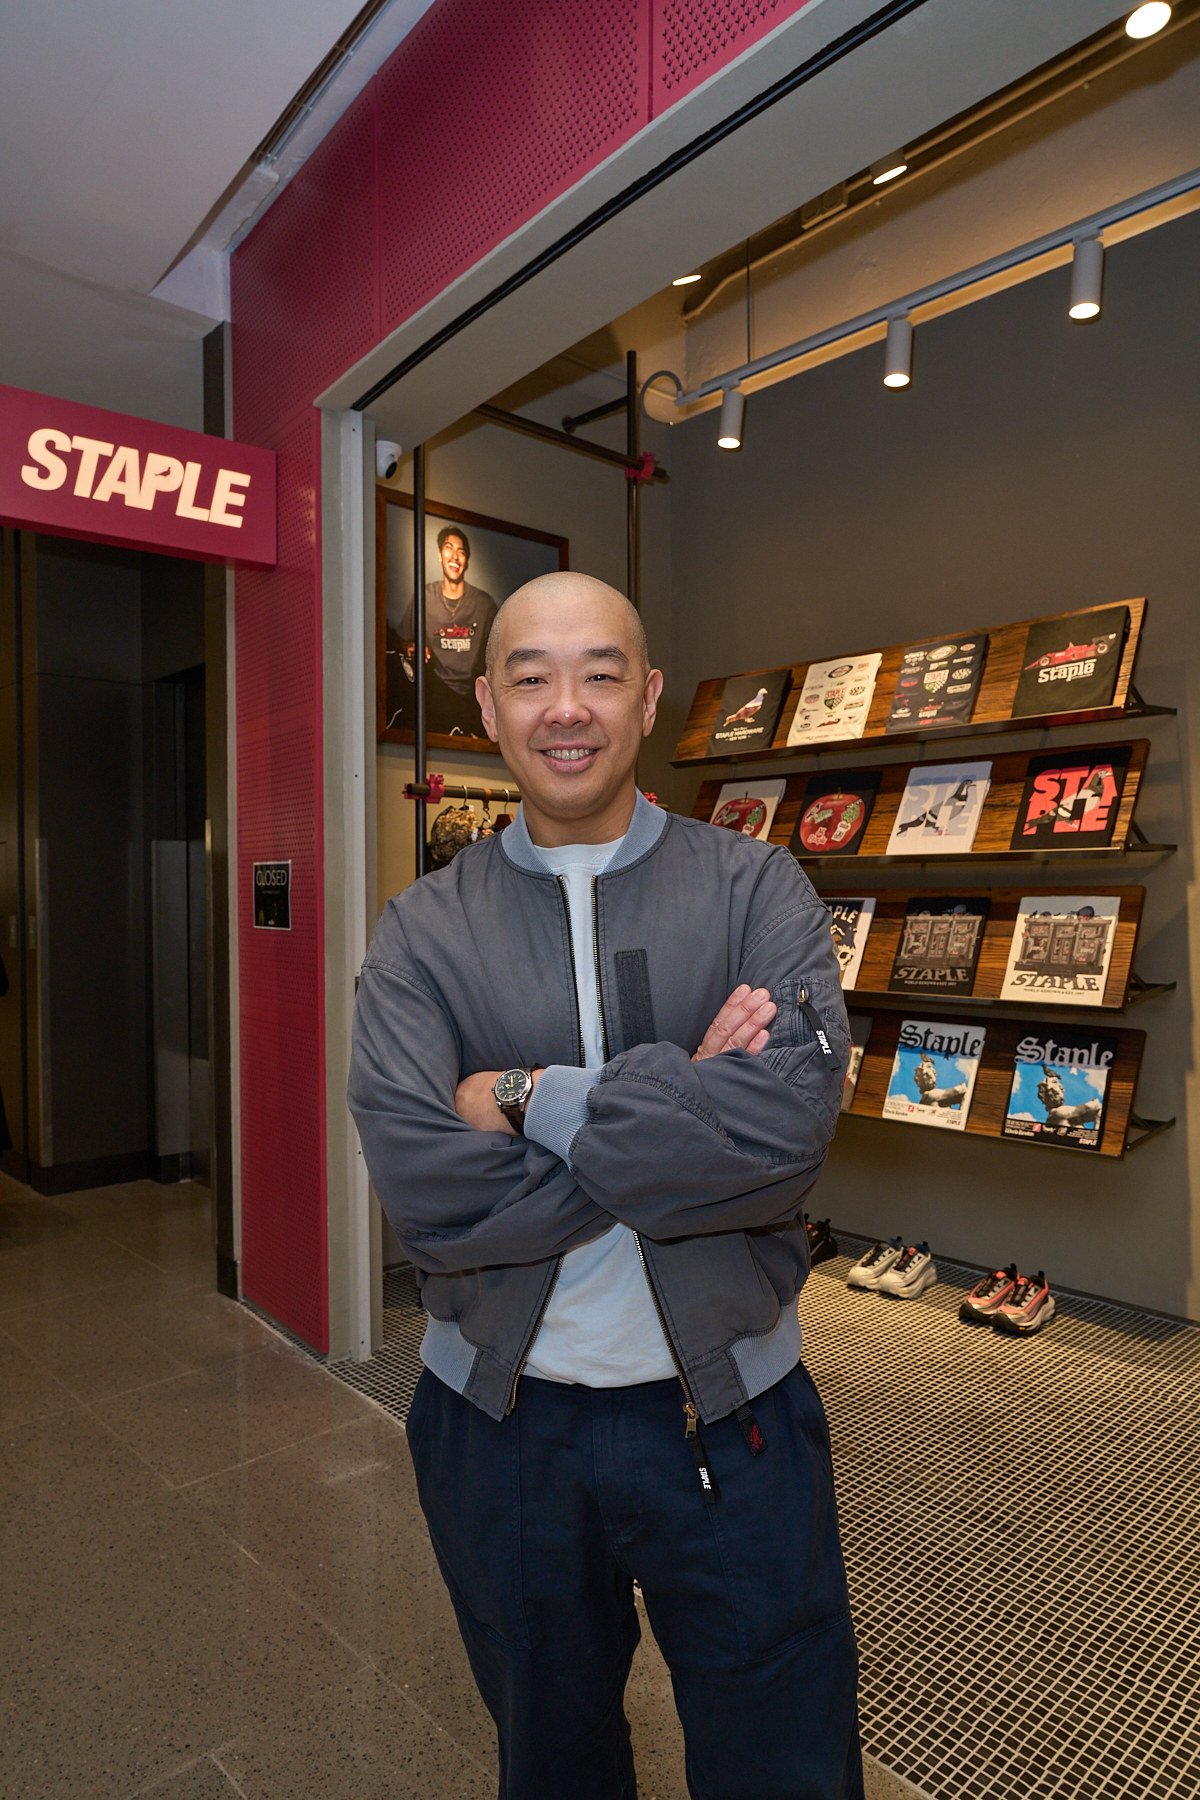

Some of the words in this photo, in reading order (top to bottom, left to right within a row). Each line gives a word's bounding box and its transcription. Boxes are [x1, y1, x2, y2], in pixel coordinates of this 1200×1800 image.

[21, 428, 251, 528] STAPLE
[441, 638, 471, 652] Staple
[1038, 658, 1097, 683] Staple
[1029, 763, 1118, 803] STA
[256, 870, 287, 886] CLOSED
[894, 966, 969, 981] STAPLE
[1010, 974, 1099, 991] STAPLE
[816, 1030, 832, 1054] STAPLE
[898, 1024, 985, 1060] Staple
[1014, 1036, 1113, 1075] Staple
[699, 1467, 712, 1490] STAPLE
